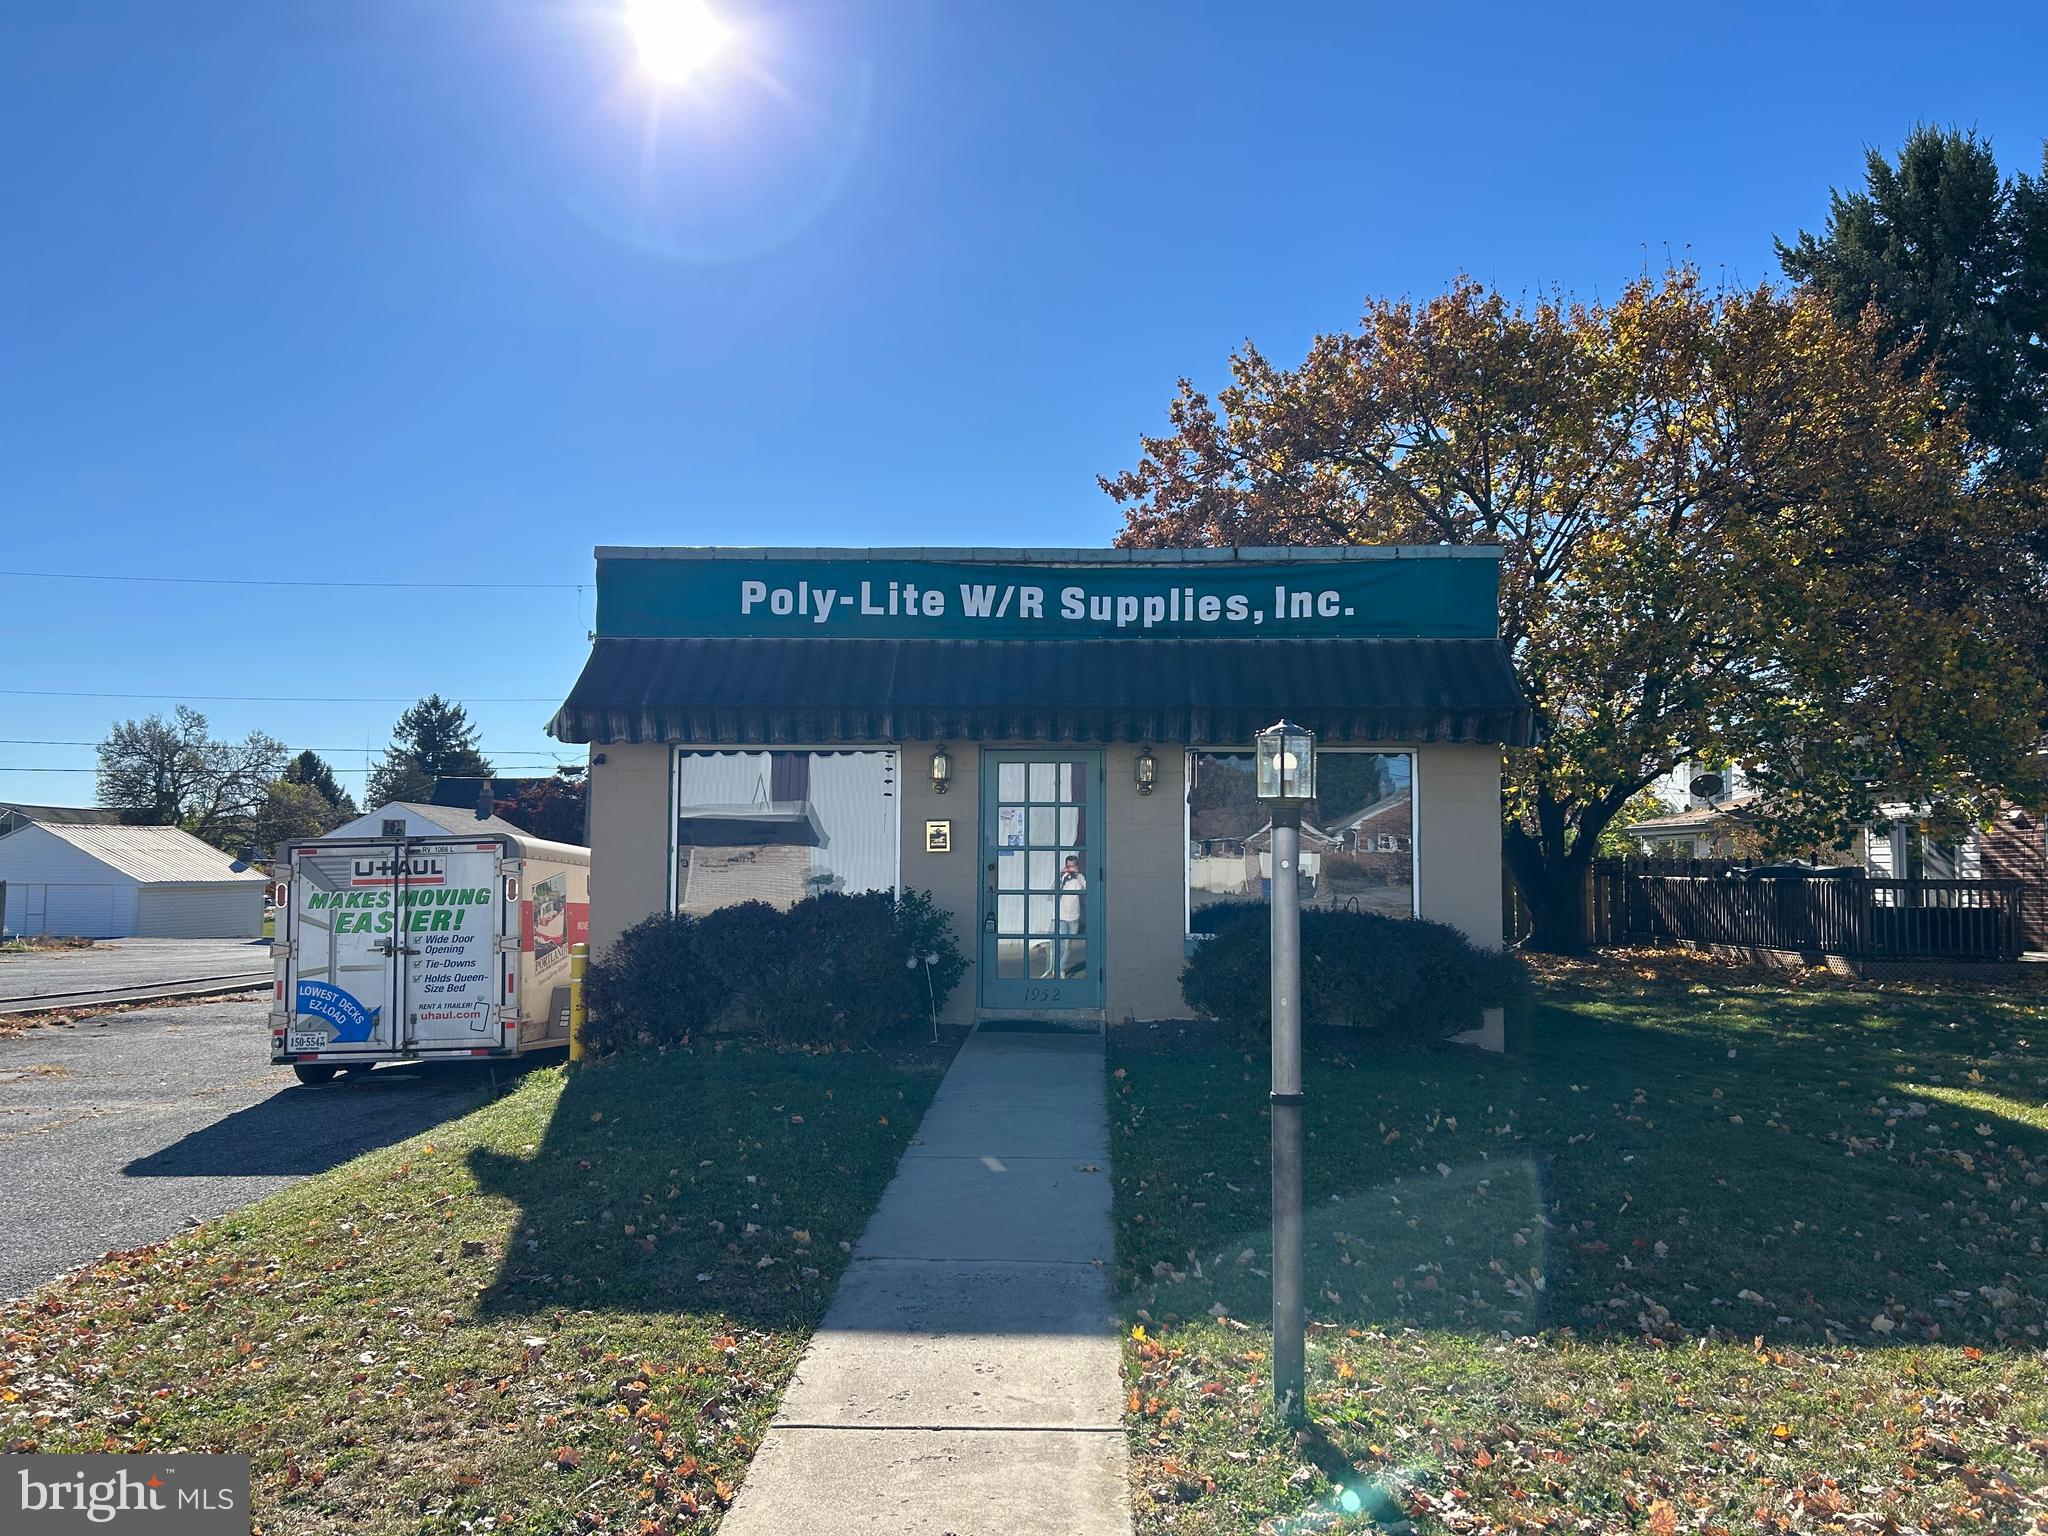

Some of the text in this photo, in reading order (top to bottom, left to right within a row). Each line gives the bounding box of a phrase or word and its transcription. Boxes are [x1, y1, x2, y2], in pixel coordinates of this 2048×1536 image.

[741, 580, 1355, 628] Poly-Lite W/R Supplies, Inc.
[354, 859, 443, 877] U-HAUL
[308, 888, 491, 909] MAKES MOVING
[334, 909, 466, 934] EASIER!
[425, 934, 475, 944] Wide Door
[425, 944, 465, 955] Opening
[425, 959, 476, 969] Tie-Downs
[424, 973, 488, 983] Holds Queen-
[424, 983, 466, 993] Size Bed
[1024, 986, 1061, 1002] 1952
[300, 985, 365, 1025] LOWEST DECKS
[309, 999, 347, 1025] EZ-LOAD
[420, 1011, 481, 1020] uhaul.com
